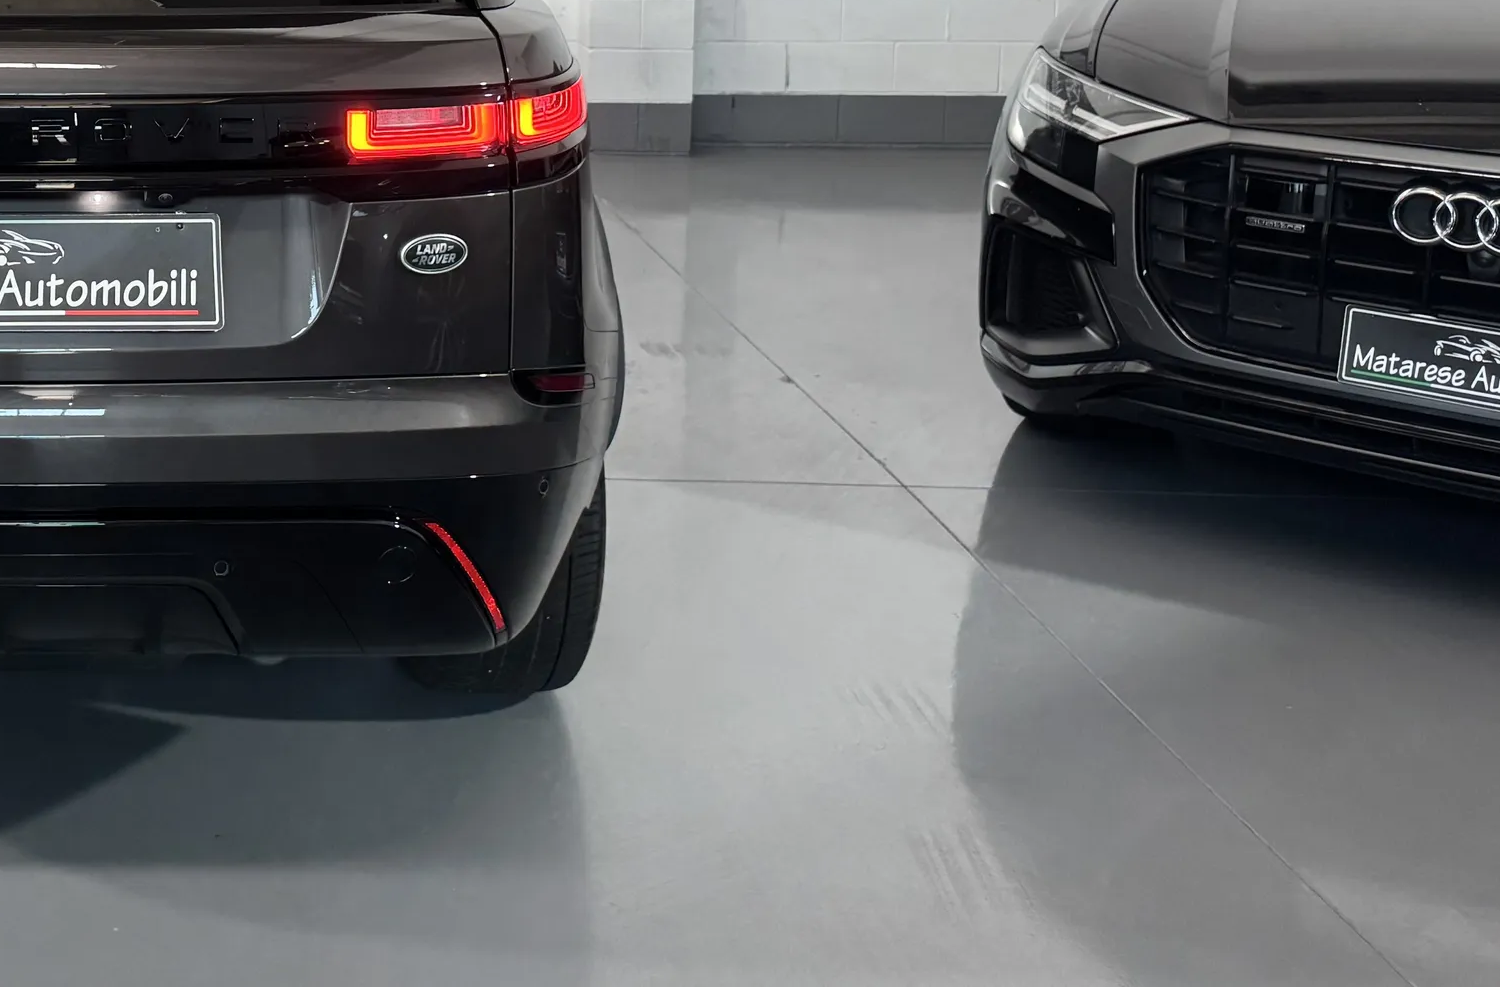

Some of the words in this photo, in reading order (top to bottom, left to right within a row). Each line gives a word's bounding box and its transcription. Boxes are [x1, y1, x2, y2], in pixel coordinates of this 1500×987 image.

[416, 242, 448, 255] LAND
[419, 253, 456, 266] ROVER
[1352, 344, 1466, 387] Matarese
